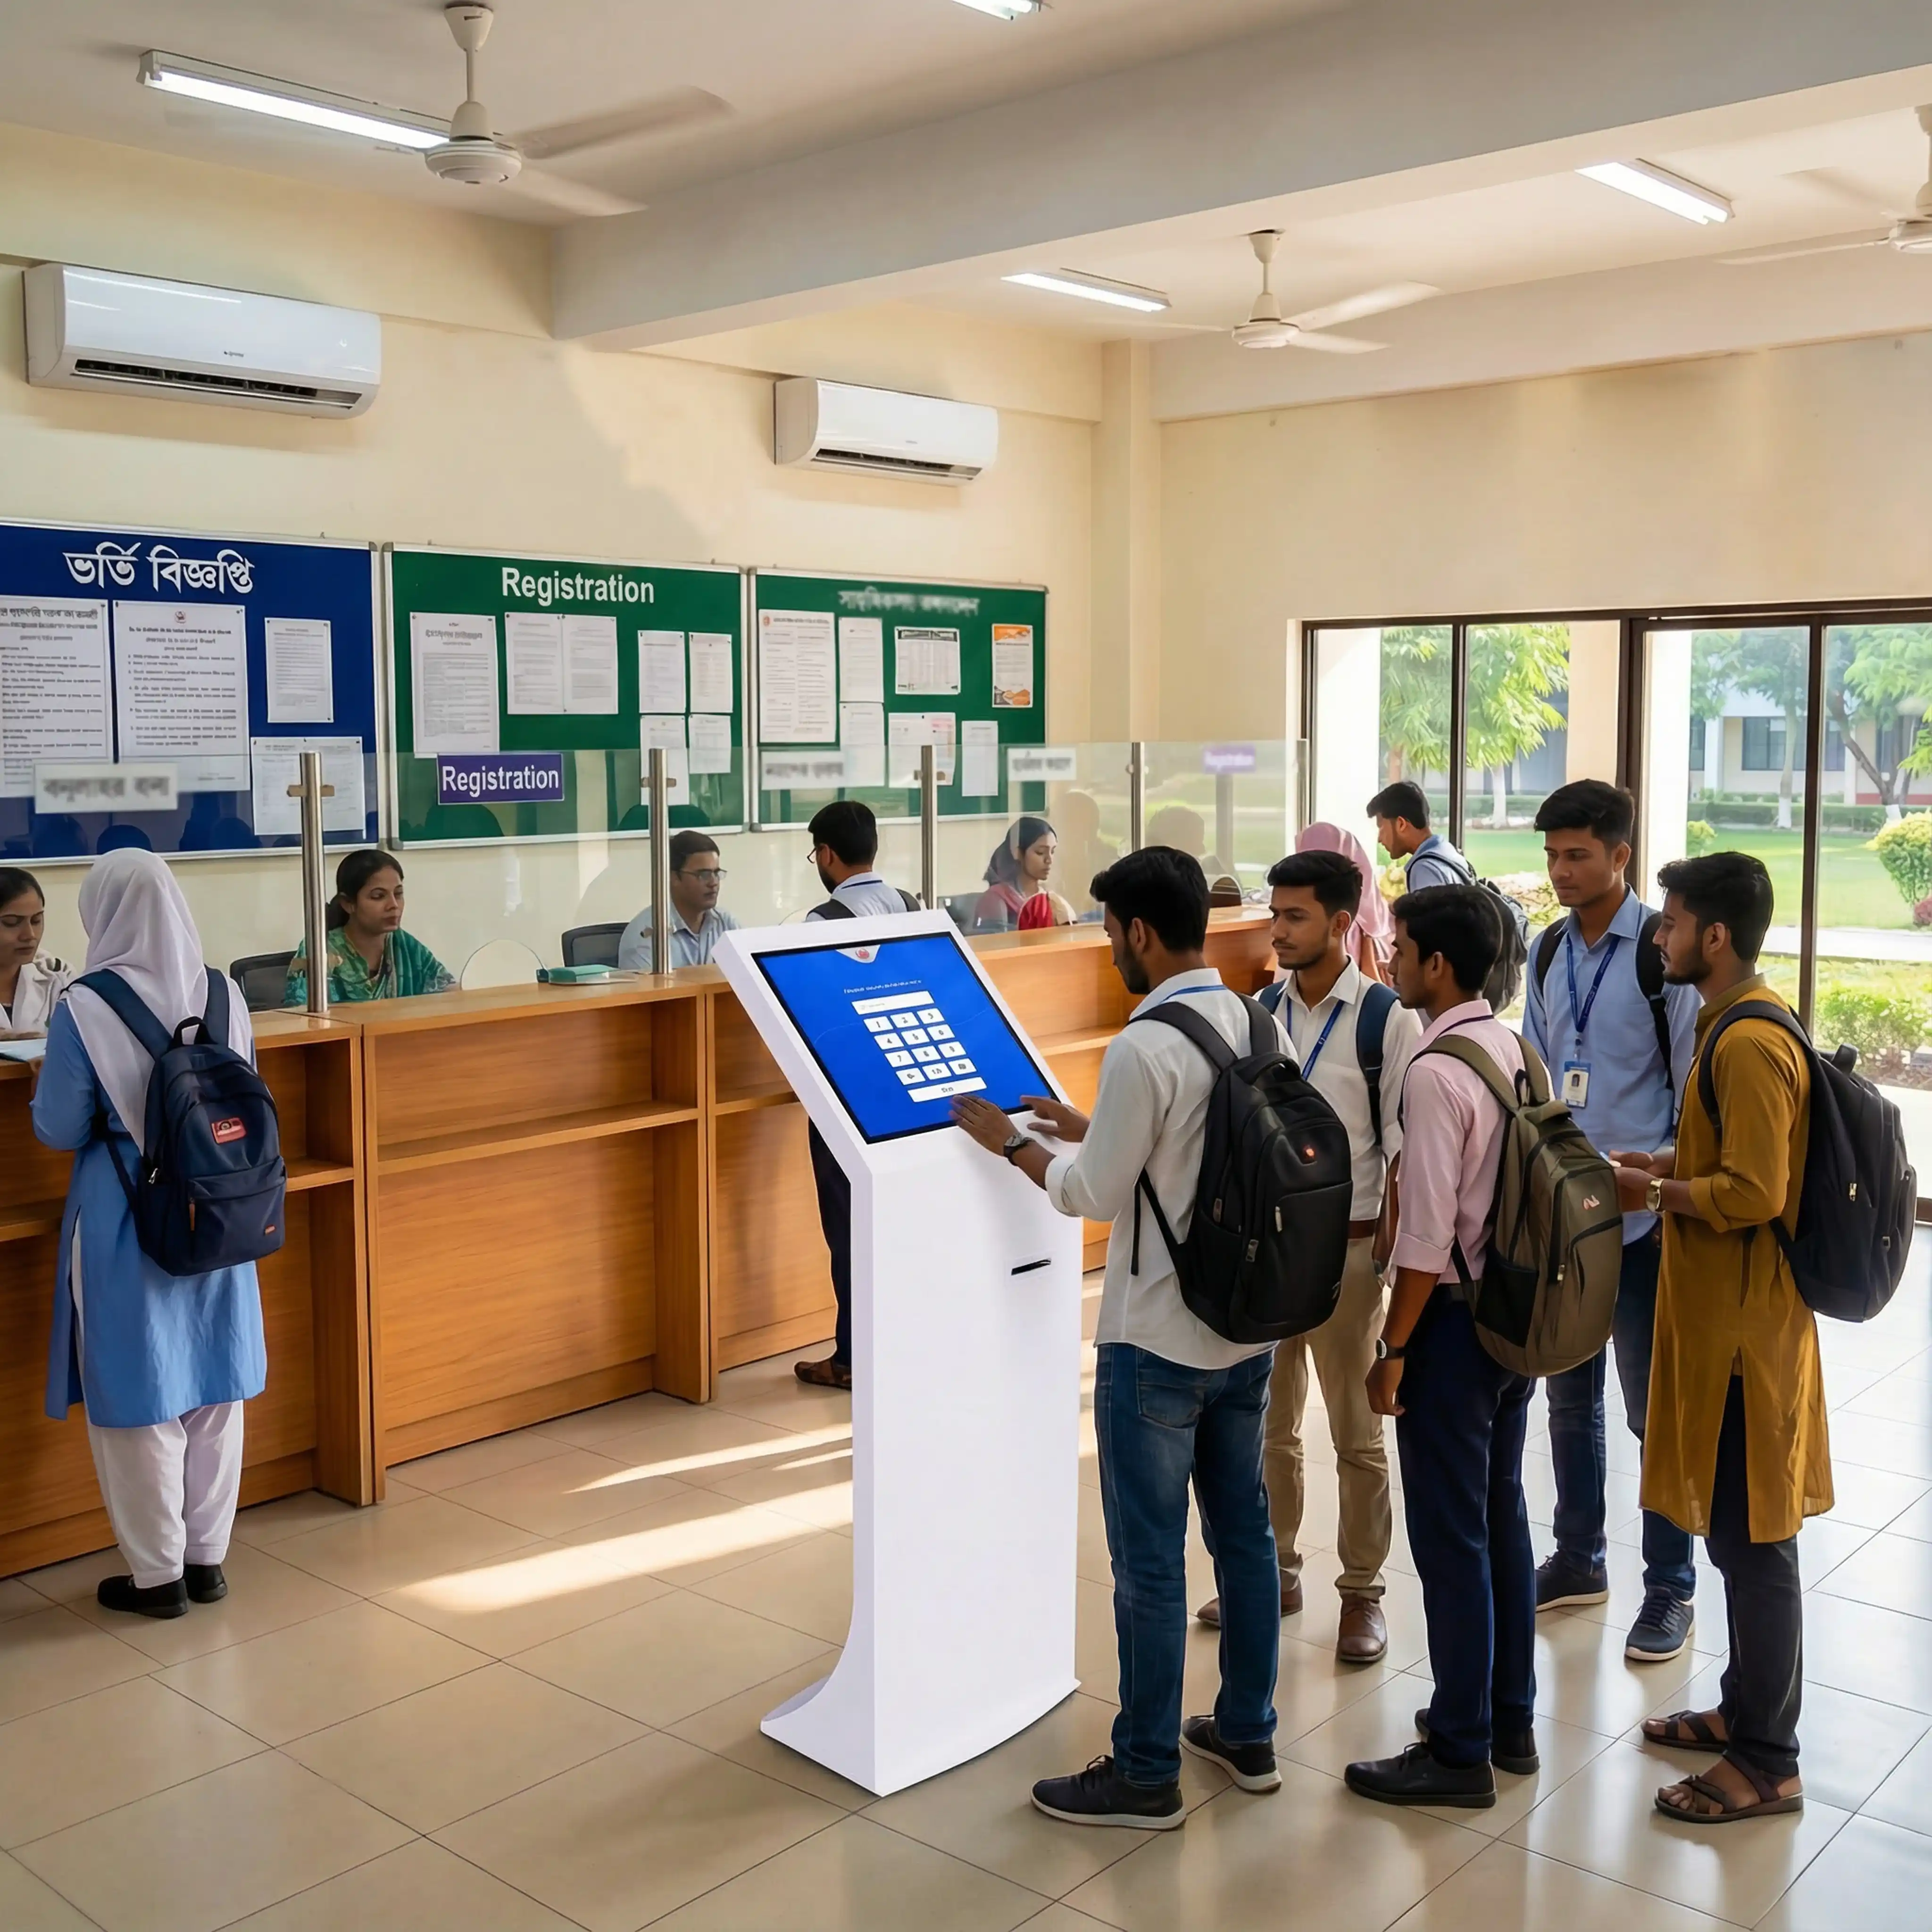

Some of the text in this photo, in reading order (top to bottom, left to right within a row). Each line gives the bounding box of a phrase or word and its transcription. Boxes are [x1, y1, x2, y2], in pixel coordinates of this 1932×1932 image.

[146, 544, 255, 594] বিজ্ঞপ্তি
[502, 567, 654, 607] Registration
[442, 765, 559, 798] Registration
